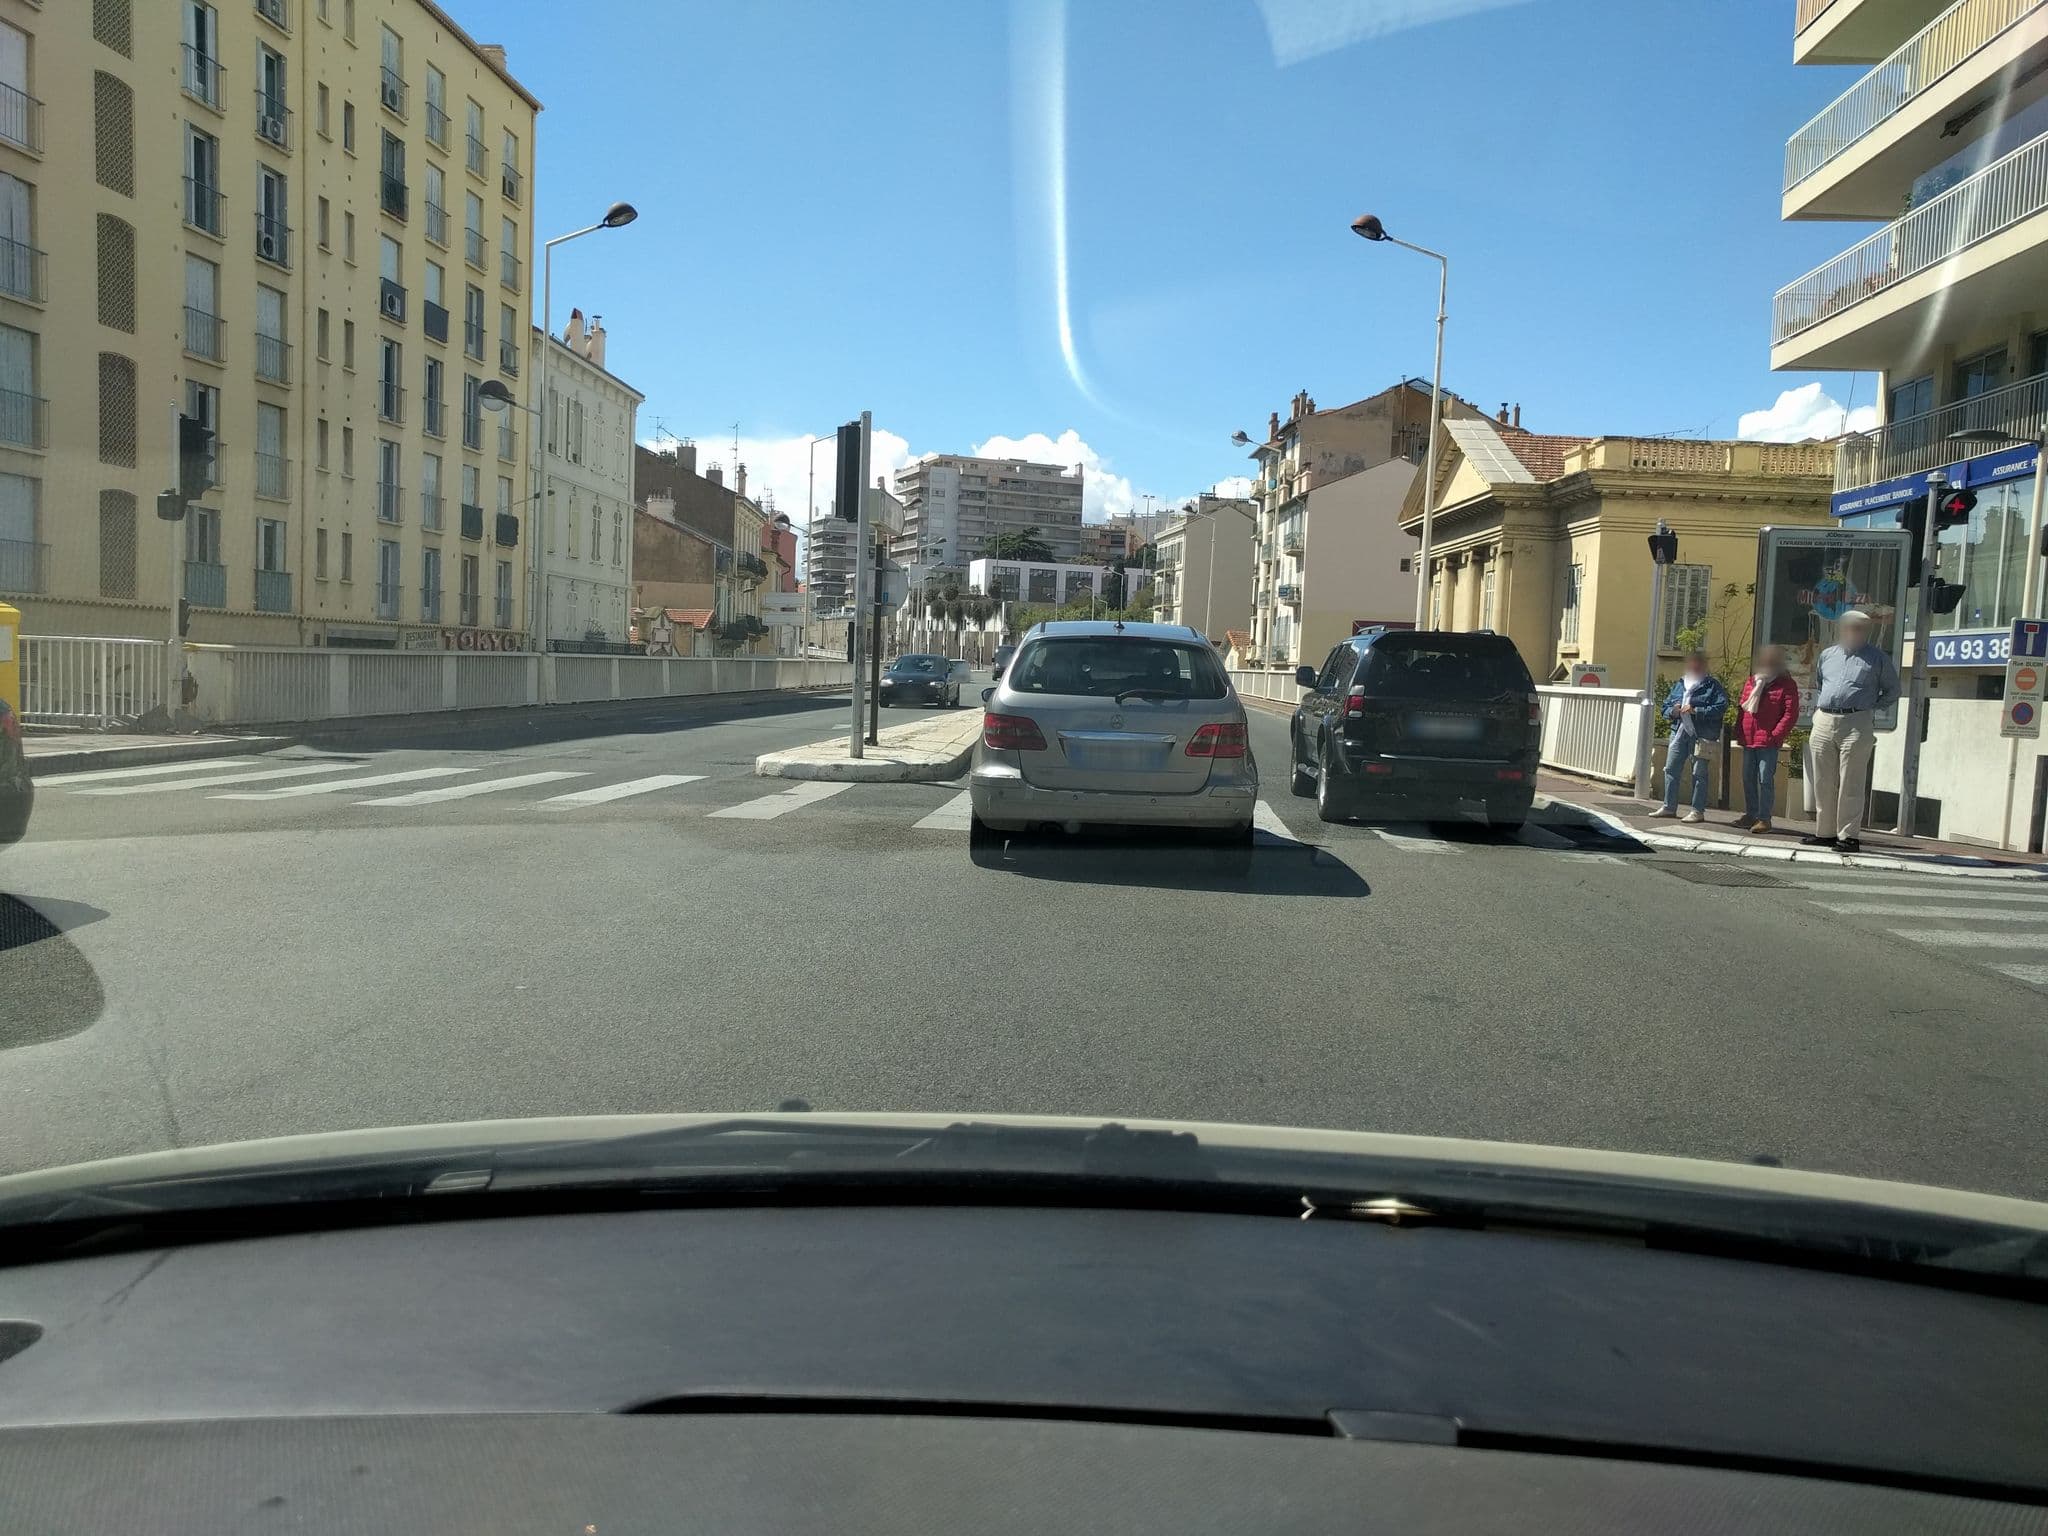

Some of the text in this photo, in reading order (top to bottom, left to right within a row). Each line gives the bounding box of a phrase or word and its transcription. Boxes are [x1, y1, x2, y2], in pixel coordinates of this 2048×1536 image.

[1991, 460, 2029, 477] ASSURANCE
[441, 629, 516, 651] TOKYO
[1934, 638, 2010, 660] 04 93 38
